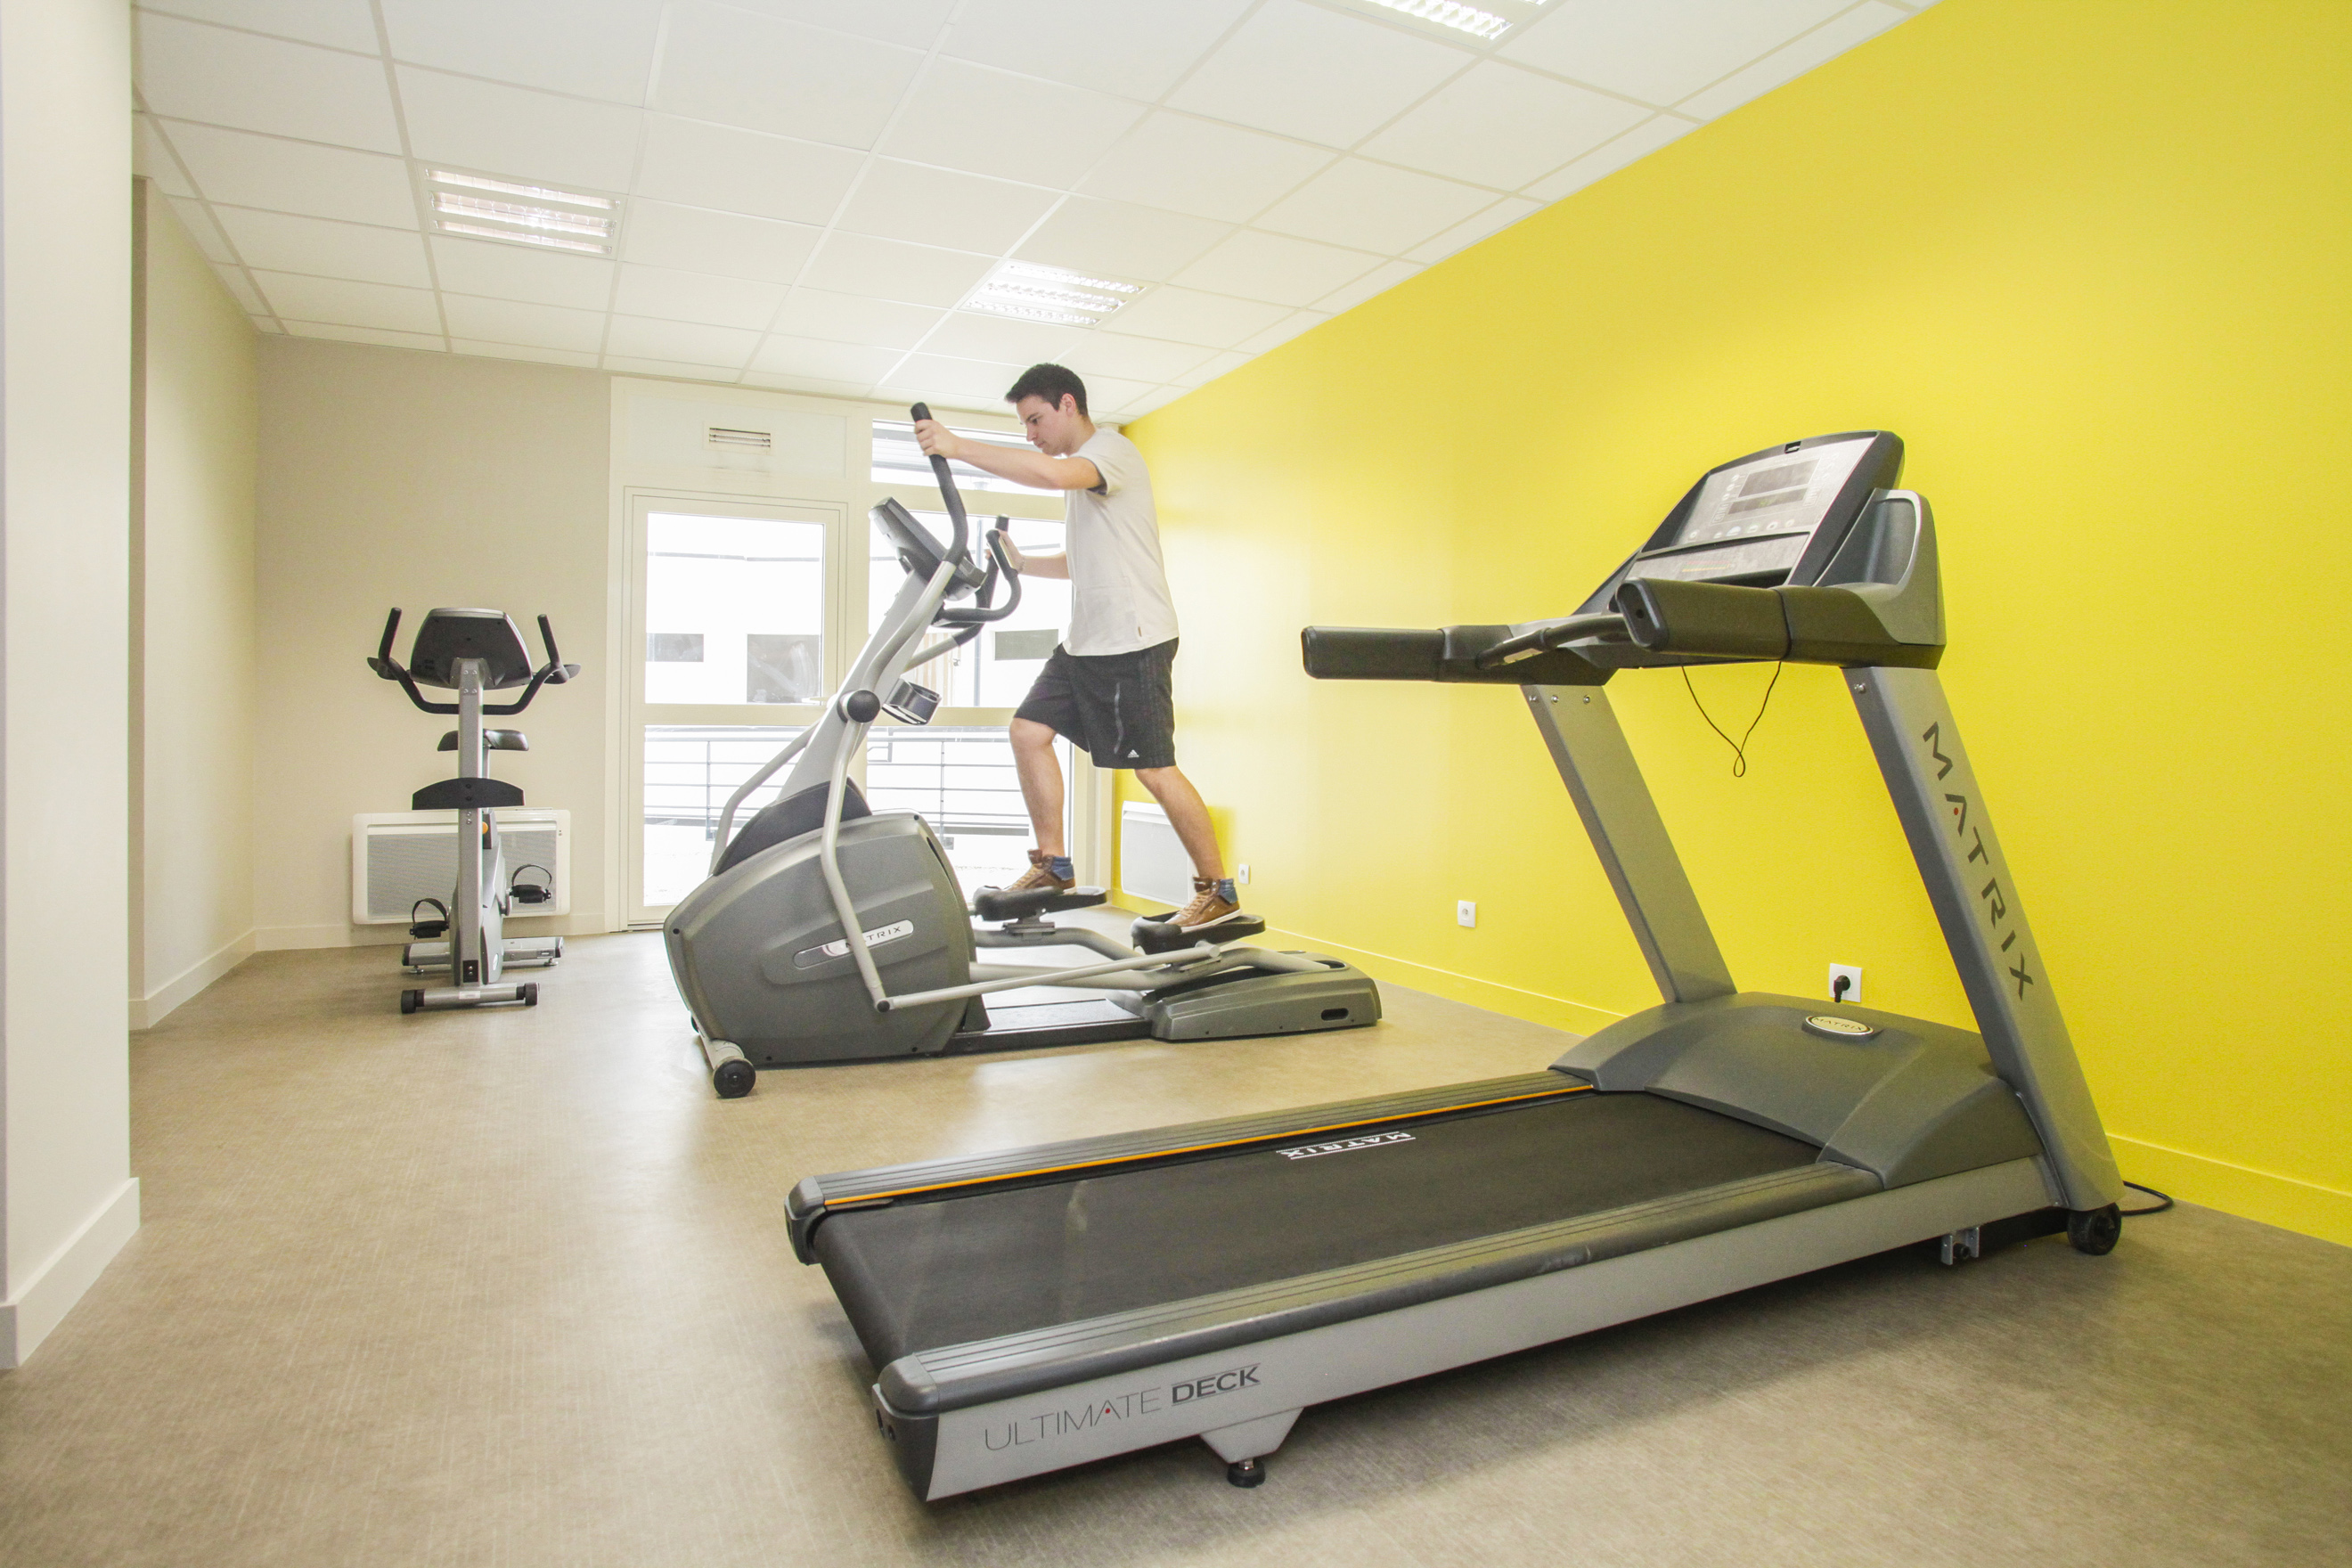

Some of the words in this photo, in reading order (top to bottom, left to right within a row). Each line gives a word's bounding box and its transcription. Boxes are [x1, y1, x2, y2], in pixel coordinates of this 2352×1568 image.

[1922, 721, 2034, 1001] MATRIX
[1813, 1017, 1863, 1031] MATRIX
[1280, 1131, 1412, 1157] MATRIX
[984, 1386, 1162, 1451] ULTIMATE
[1171, 1363, 1262, 1406] DECK
